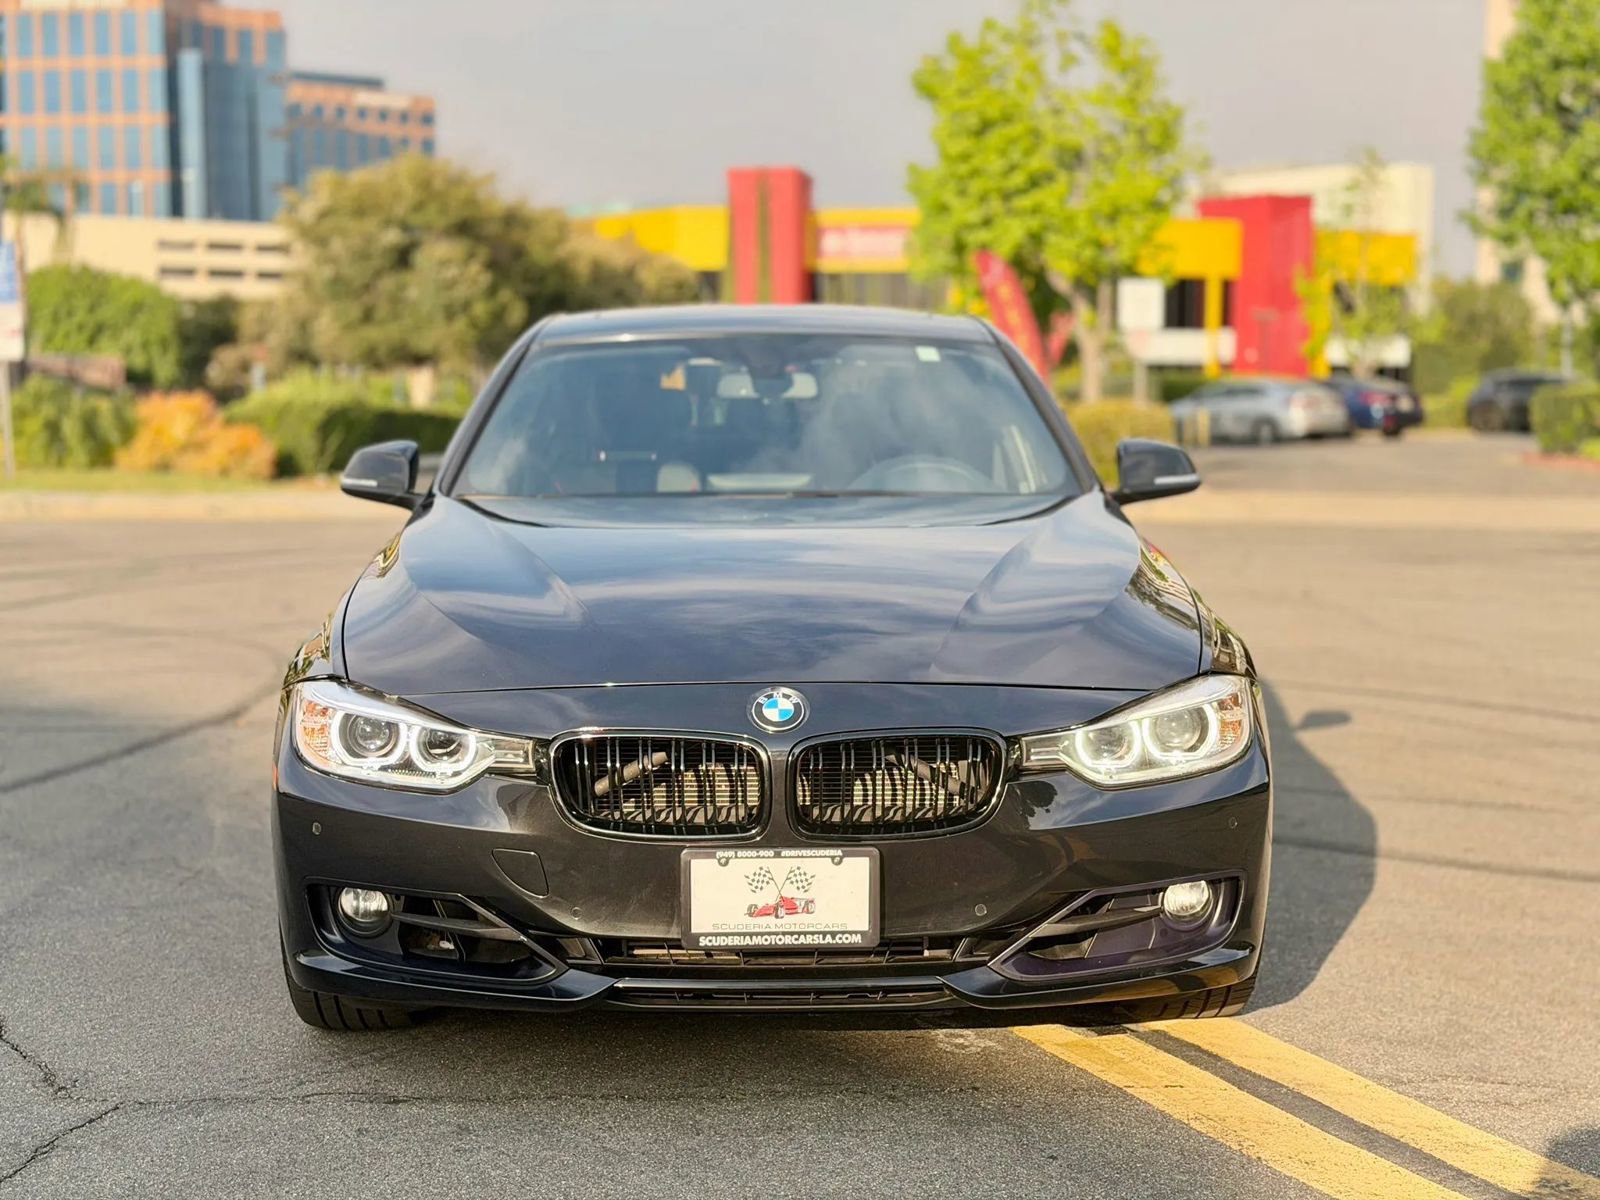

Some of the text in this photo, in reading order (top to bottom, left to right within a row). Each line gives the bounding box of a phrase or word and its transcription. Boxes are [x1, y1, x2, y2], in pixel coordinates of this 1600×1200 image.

[712, 922, 848, 931] SCUDERIA MOTORCARS
[699, 934, 862, 946] SCUDERIAMOTORCARSLA.COM
